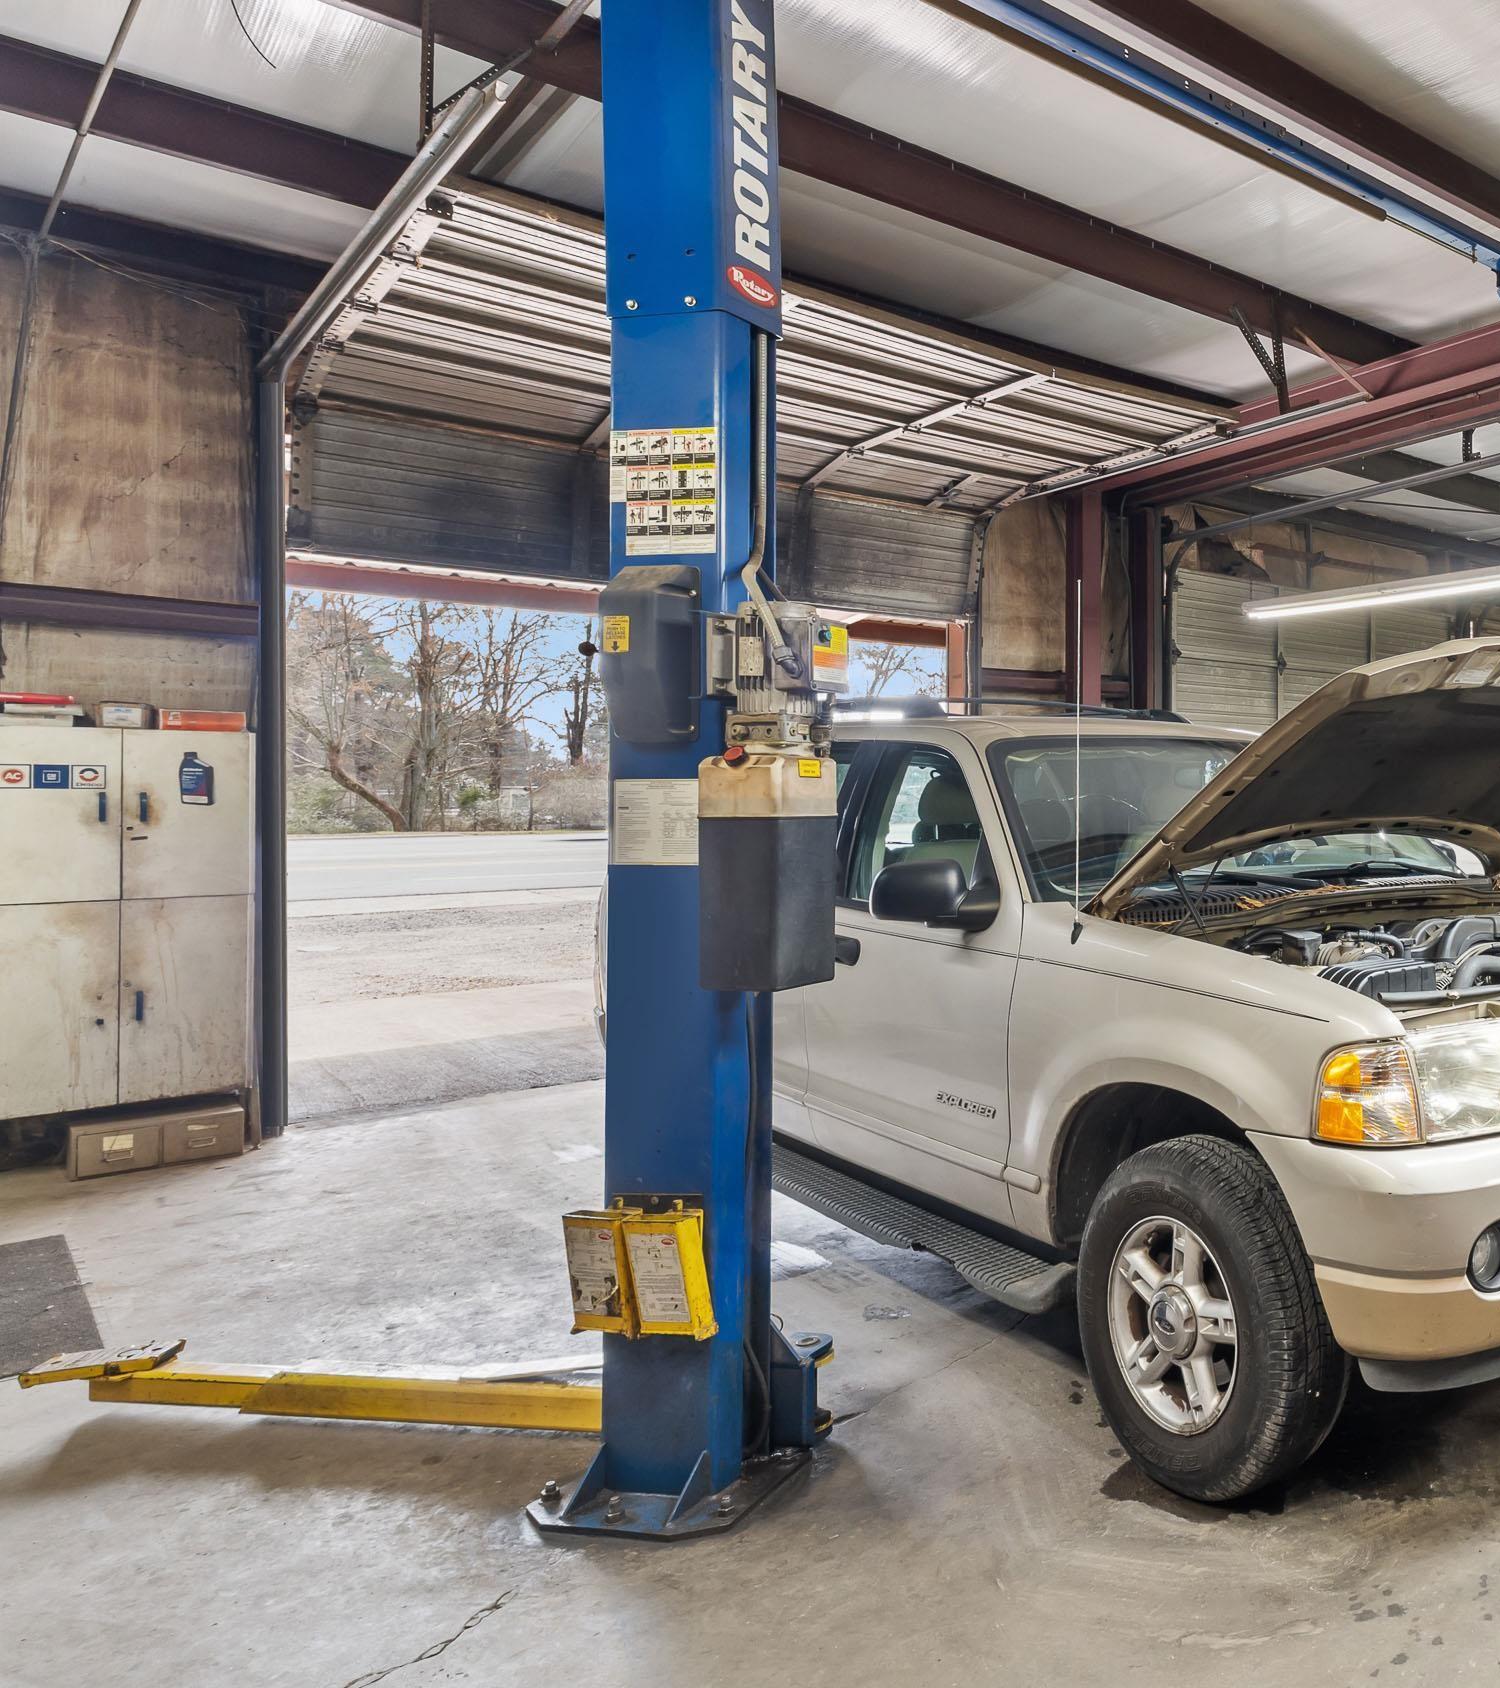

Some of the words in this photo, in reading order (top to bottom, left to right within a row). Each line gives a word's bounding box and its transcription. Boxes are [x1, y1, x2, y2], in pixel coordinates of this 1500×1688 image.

[731, 0, 771, 271] ROTARY
[732, 267, 774, 301] Rotary
[4, 771, 22, 781] AC
[936, 1090, 997, 1120] EXPLORER
